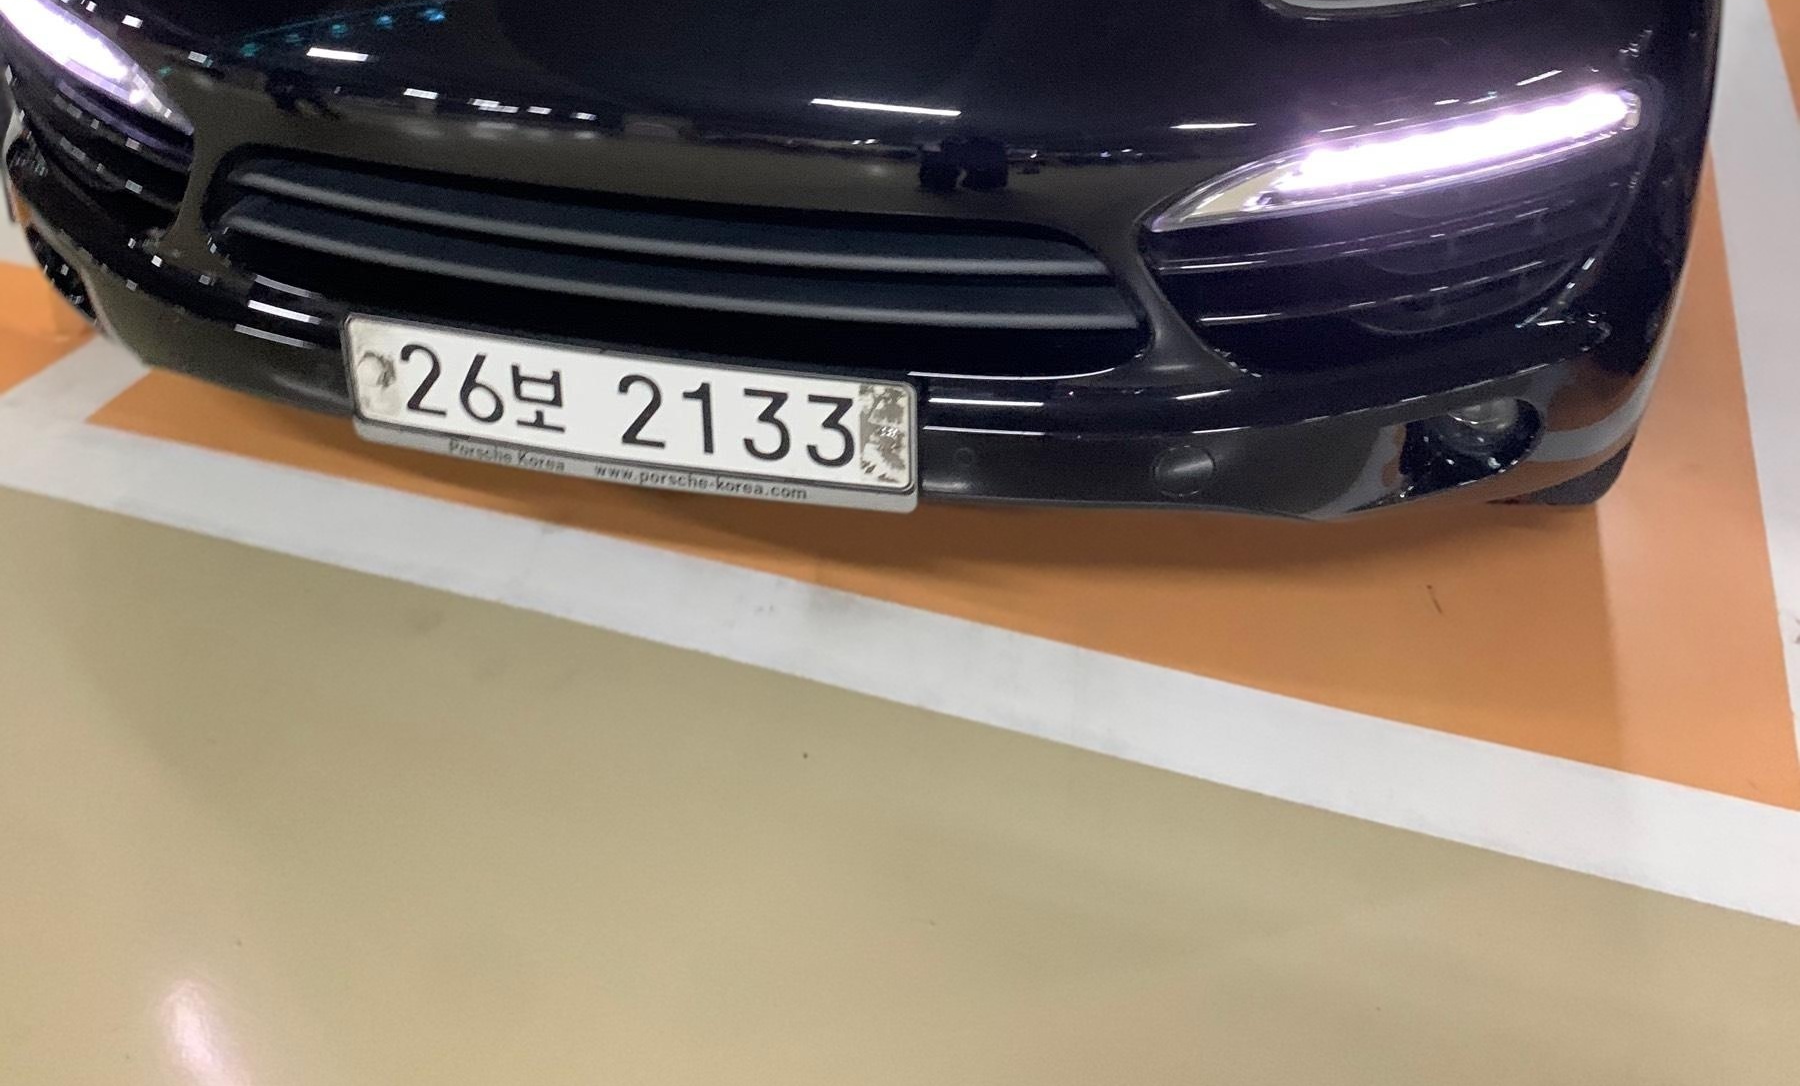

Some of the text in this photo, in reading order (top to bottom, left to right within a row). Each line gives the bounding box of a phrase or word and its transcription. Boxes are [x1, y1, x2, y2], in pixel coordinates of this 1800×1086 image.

[399, 343, 857, 468] 26보 2133
[448, 439, 809, 500] Porsche Korea www.porsche-korea.com
